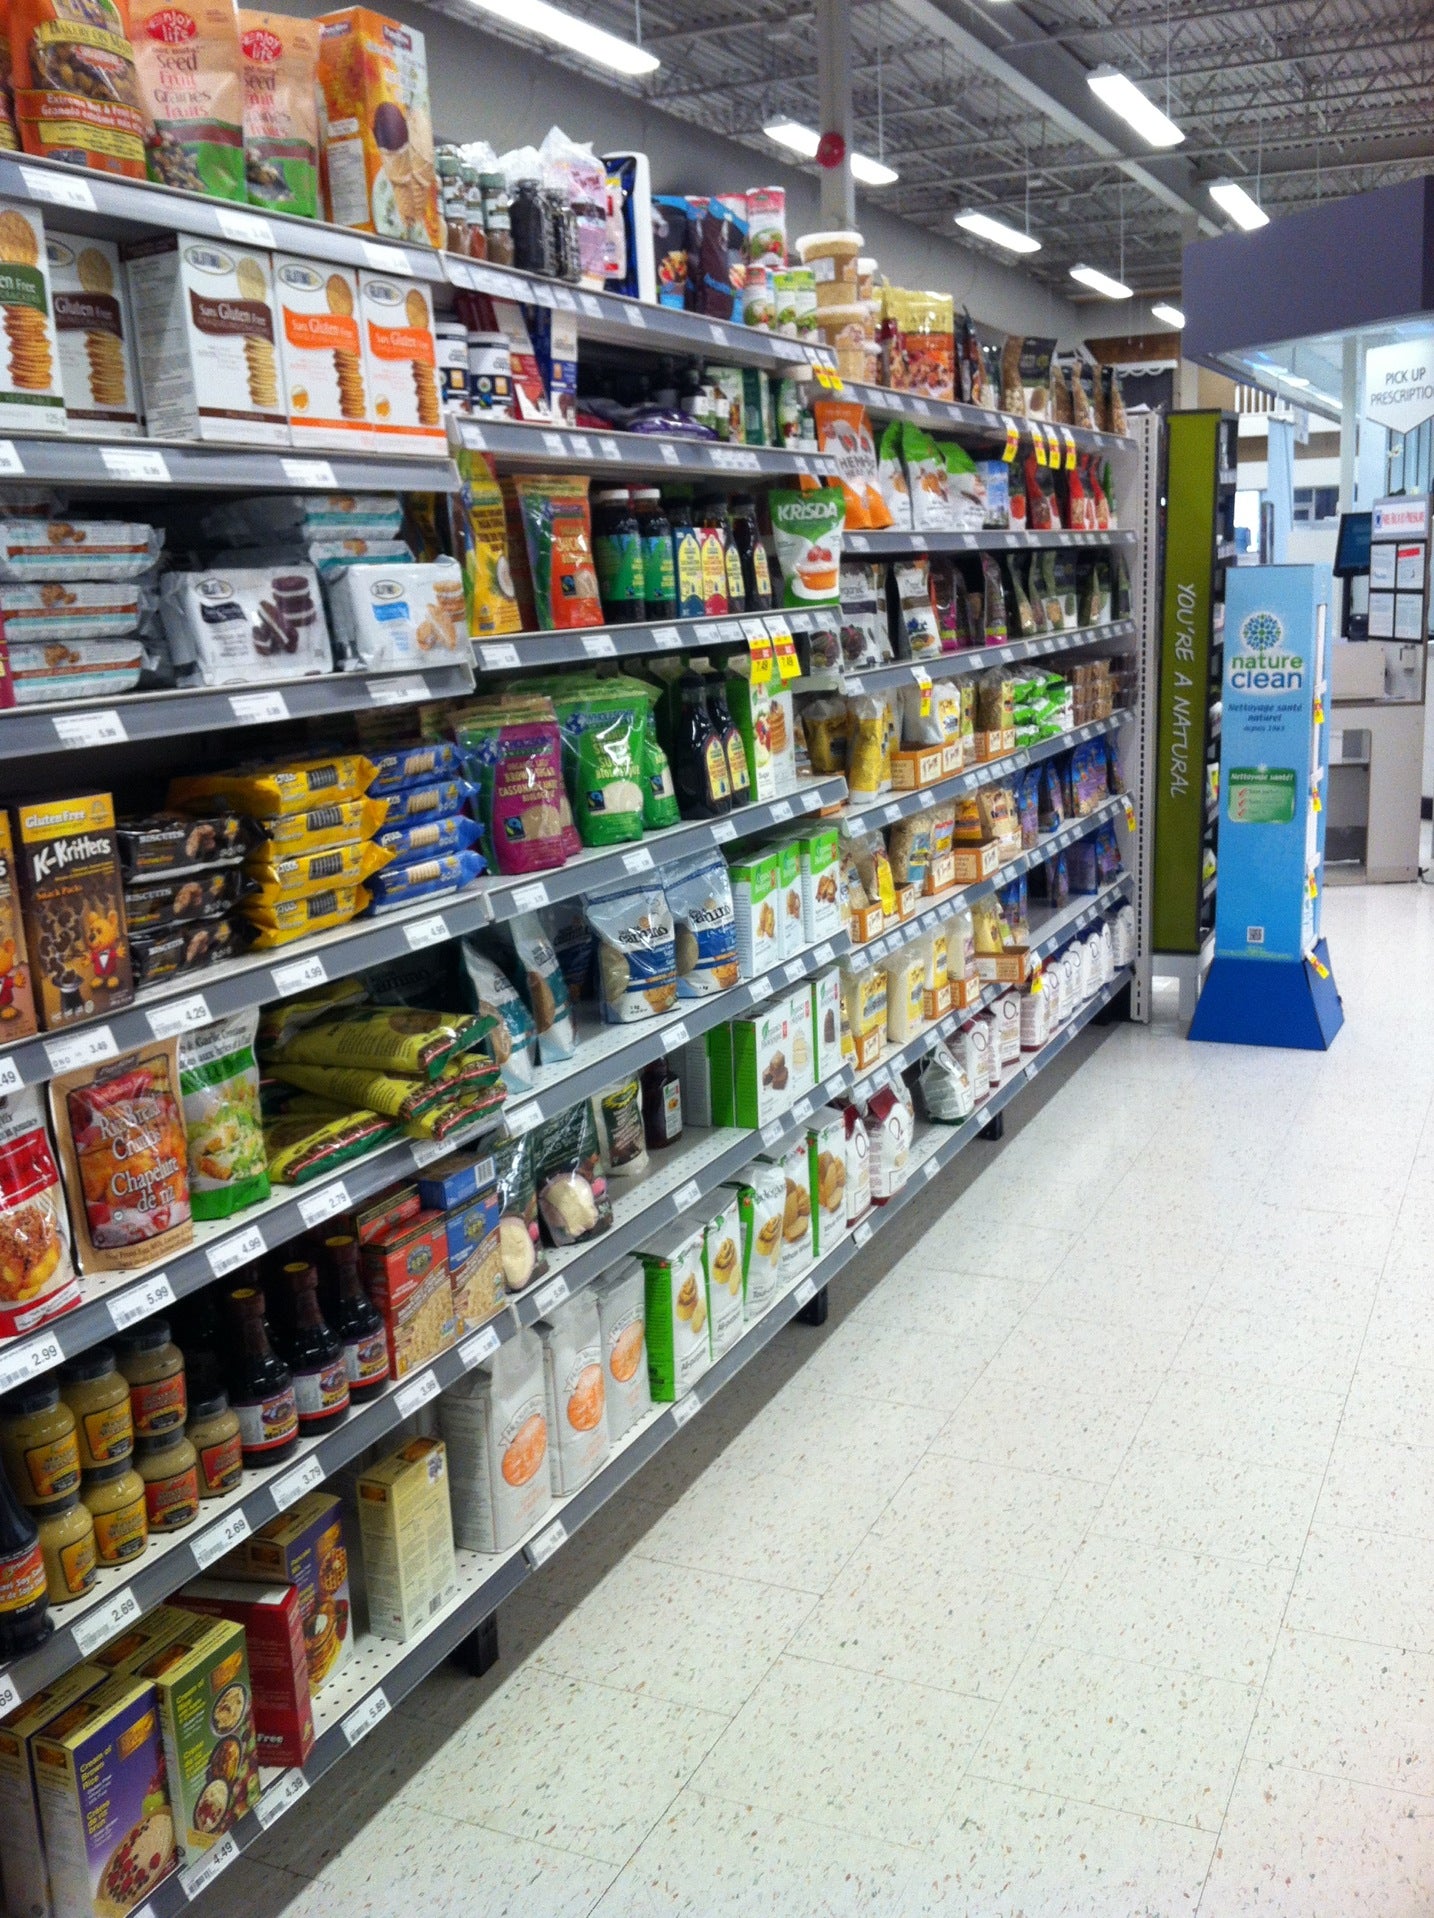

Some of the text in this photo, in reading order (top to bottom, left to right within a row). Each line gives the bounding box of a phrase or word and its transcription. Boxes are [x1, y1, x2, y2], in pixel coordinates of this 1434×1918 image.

[156, 53, 198, 71] Seed
[1385, 367, 1426, 385] PICK UP
[1231, 654, 1303, 669] nature
[1231, 671, 1302, 688] clean
[1170, 583, 1197, 798] YOU'RE A NATURAL
[25, 810, 85, 828] Gluten Free
[33, 836, 112, 882] K-Kritters
[304, 966, 322, 979] 4.99
[185, 1006, 206, 1021] 4.29
[111, 1157, 179, 1196] Chapelure
[137, 1189, 157, 1213] de
[328, 1193, 347, 1208] 2.79
[242, 1237, 261, 1254] 4.99
[146, 1286, 169, 1305] 5.99
[31, 1345, 57, 1366] 2.99
[302, 1466, 321, 1485] 3.79
[225, 1519, 246, 1540] 2.69
[111, 1599, 135, 1622] 2.69
[257, 1733, 284, 1744] Free
[285, 1777, 303, 1797] 4.39
[214, 1842, 233, 1864] 4.49
